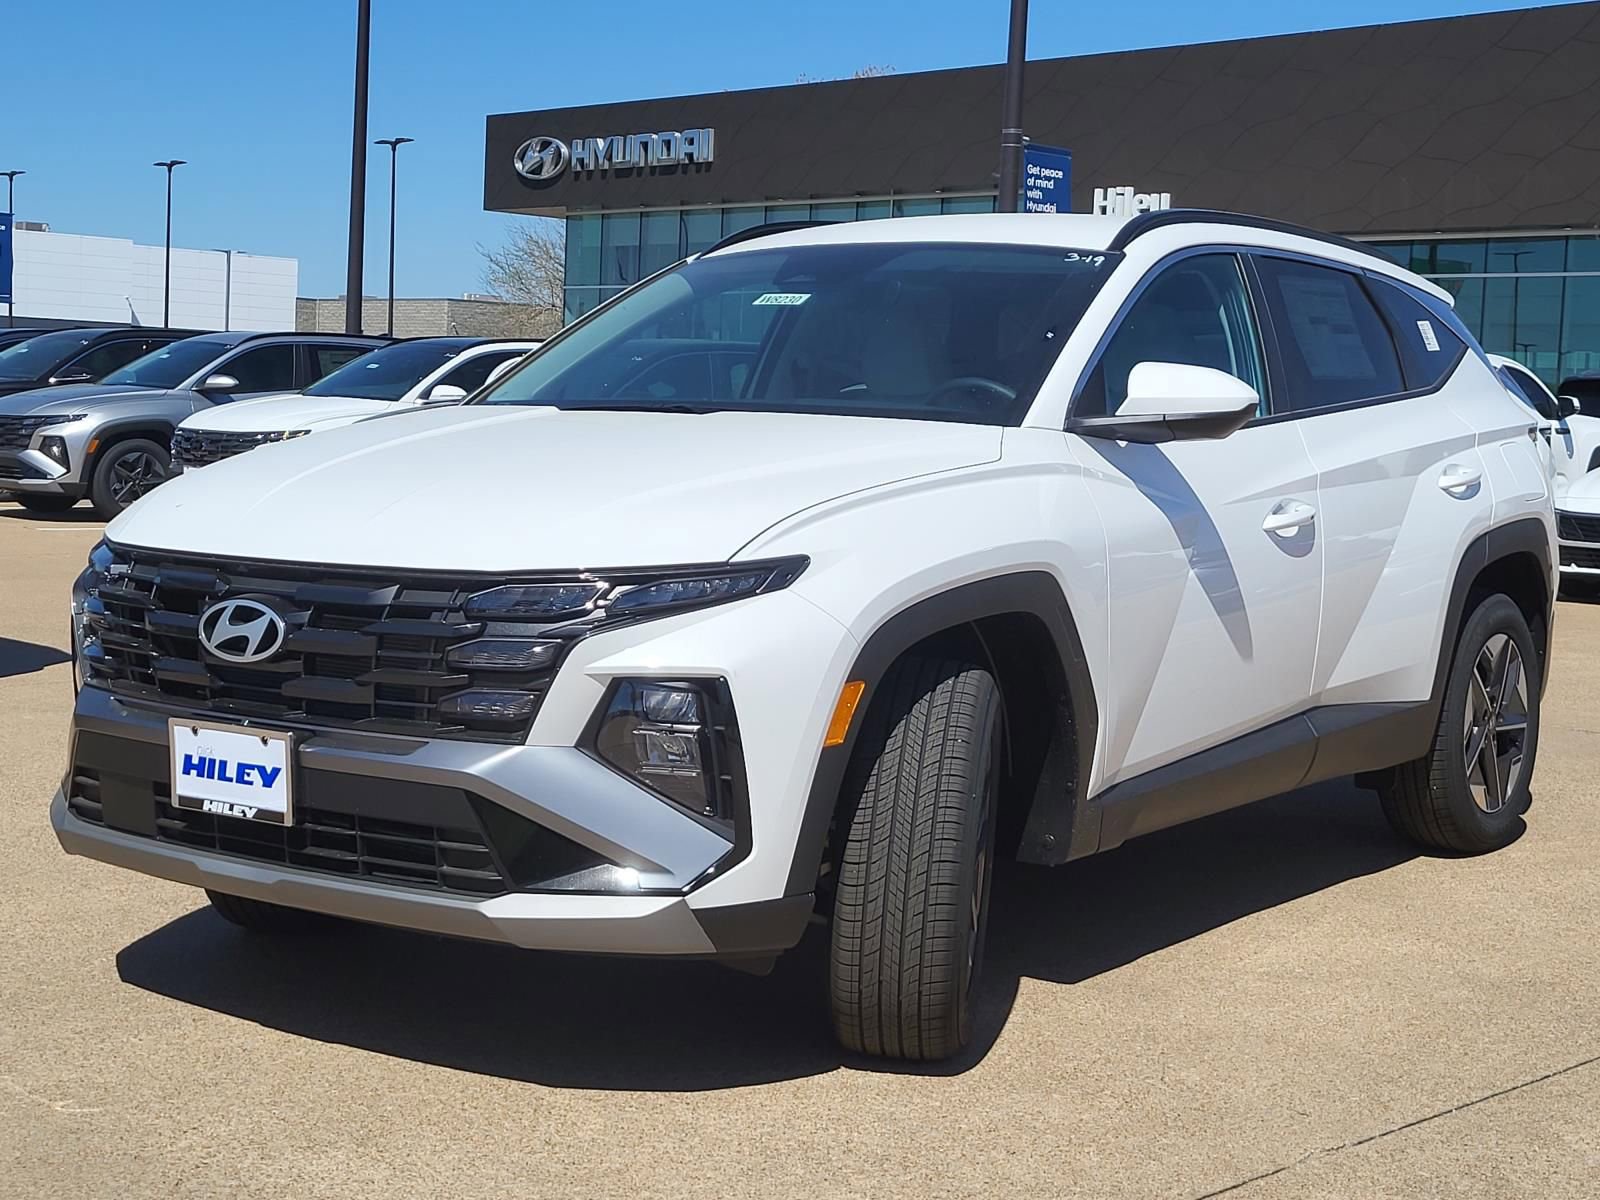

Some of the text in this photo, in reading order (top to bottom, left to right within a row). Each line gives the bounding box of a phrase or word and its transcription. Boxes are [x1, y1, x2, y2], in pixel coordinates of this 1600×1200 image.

[571, 128, 715, 172] HYUNDAI
[1026, 164, 1064, 179] Get peace
[1026, 177, 1055, 189] of mind
[1026, 188, 1043, 200] with
[1026, 200, 1057, 213] Hyundai
[182, 753, 282, 788] HILEY
[202, 799, 258, 818] HILEY
